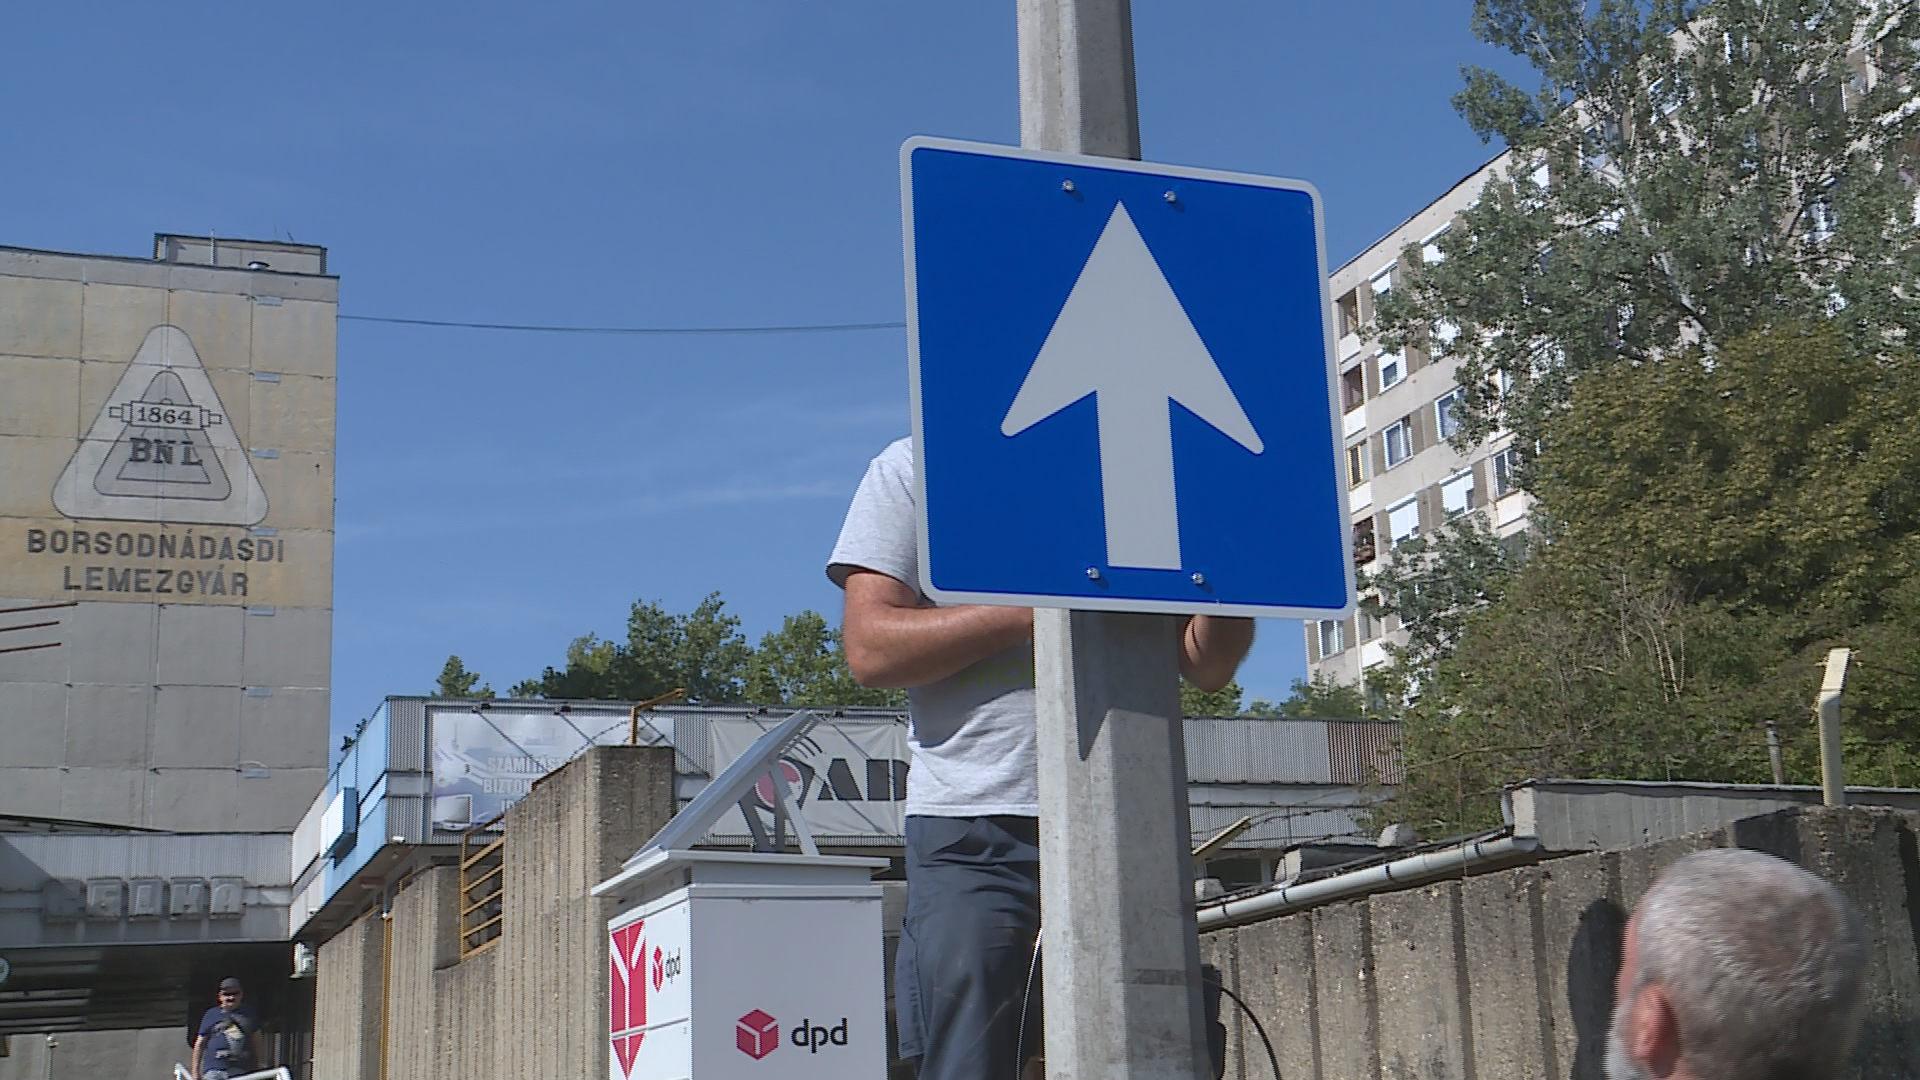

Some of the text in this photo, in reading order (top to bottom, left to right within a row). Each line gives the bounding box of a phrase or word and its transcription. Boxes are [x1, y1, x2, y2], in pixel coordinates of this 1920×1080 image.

[137, 406, 194, 426] 1864
[128, 437, 204, 467] BNL
[28, 528, 285, 563] BORSODNÁDASDI
[63, 564, 249, 597] LEMEZGYÁR
[483, 778, 533, 794] BIZTON
[665, 946, 682, 984] dpd
[791, 1017, 849, 1054] dpd
